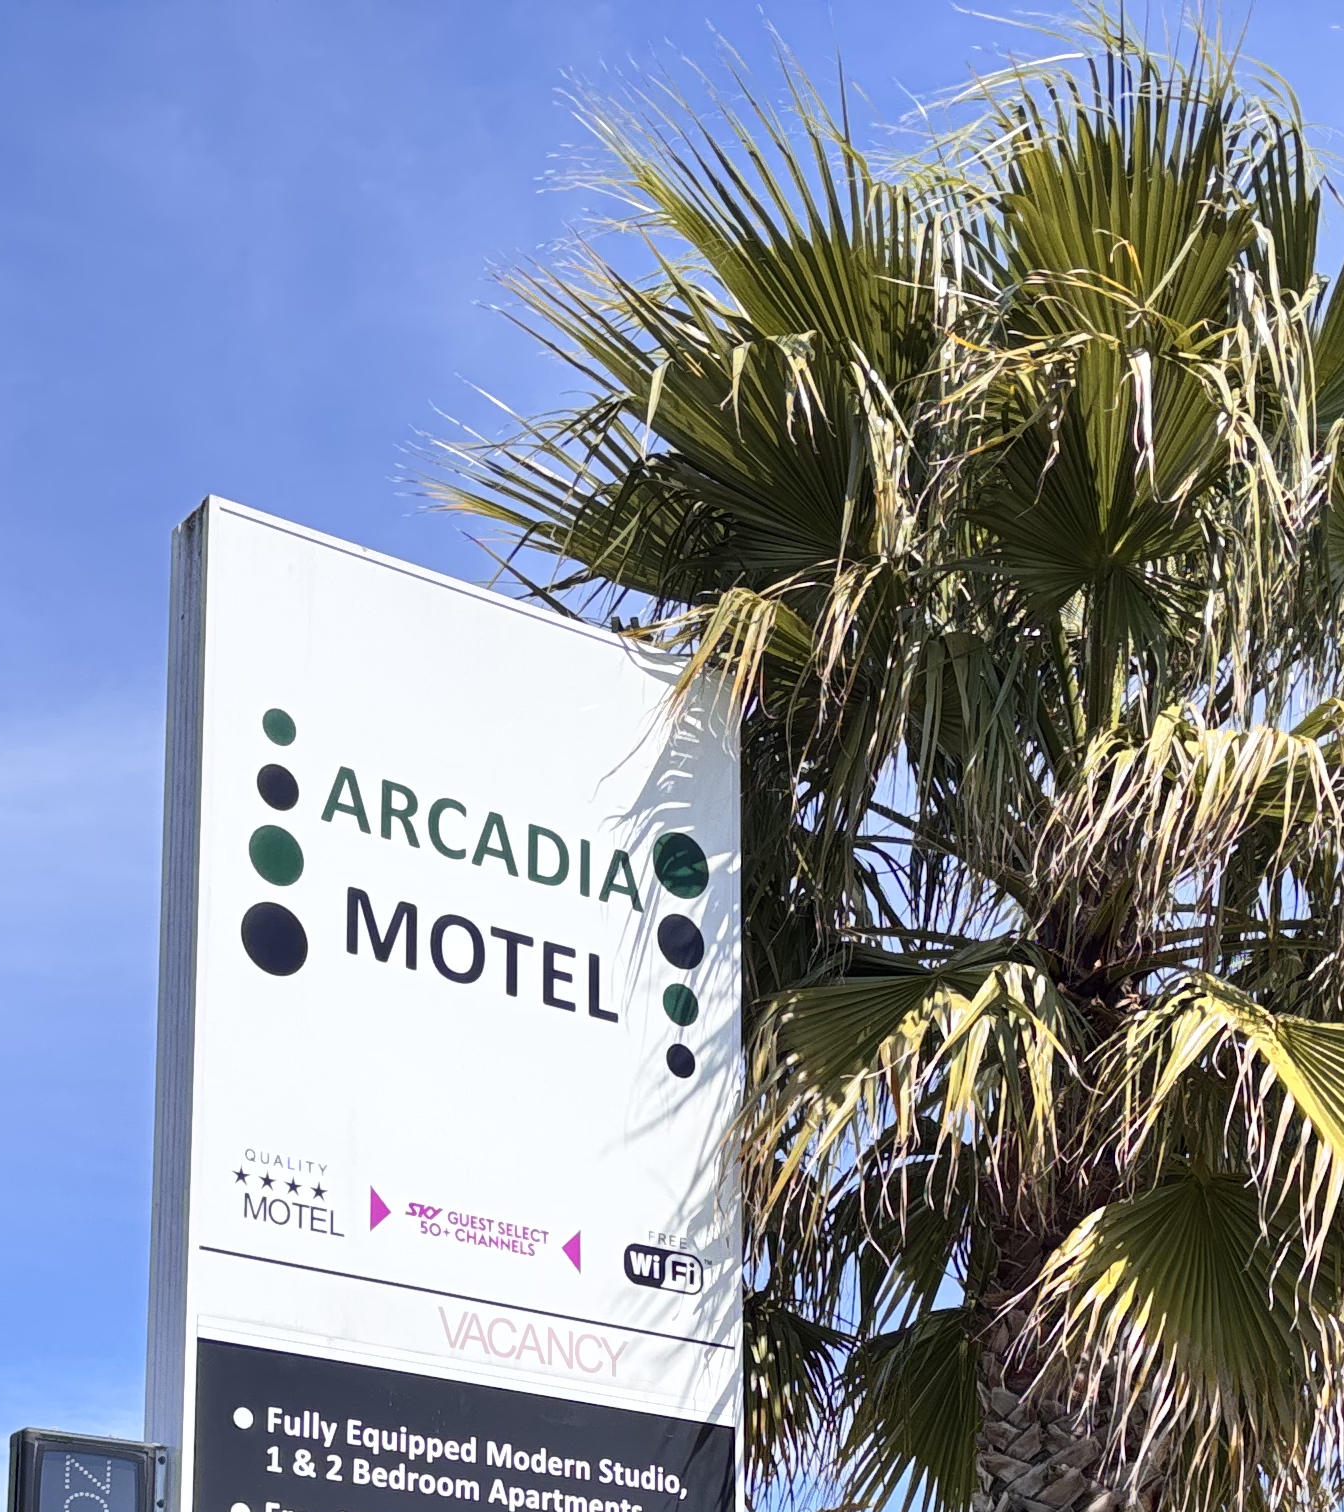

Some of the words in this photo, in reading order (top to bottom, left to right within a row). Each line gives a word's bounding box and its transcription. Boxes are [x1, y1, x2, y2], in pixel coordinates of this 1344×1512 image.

[321, 765, 644, 913] ARCADIA
[346, 886, 619, 1024] MOTEL
[245, 1149, 328, 1176] QUALITY
[244, 1192, 345, 1238] MOTEL
[420, 1220, 450, 1237] 50+
[455, 1228, 535, 1256] CHANNELS
[448, 1211, 494, 1232] GUEST
[498, 1222, 549, 1244] SELECT
[648, 1230, 688, 1250] FREE
[438, 1306, 629, 1378] VACANCY
[266, 1446, 283, 1474] 1
[292, 1449, 316, 1478] &
[325, 1454, 343, 1482] 2
[352, 1458, 480, 1501] Bedroom
[267, 1406, 338, 1448] Fully
[347, 1418, 477, 1464] Equipped
[486, 1440, 591, 1481] Modern
[599, 1458, 688, 1500] Studio,
